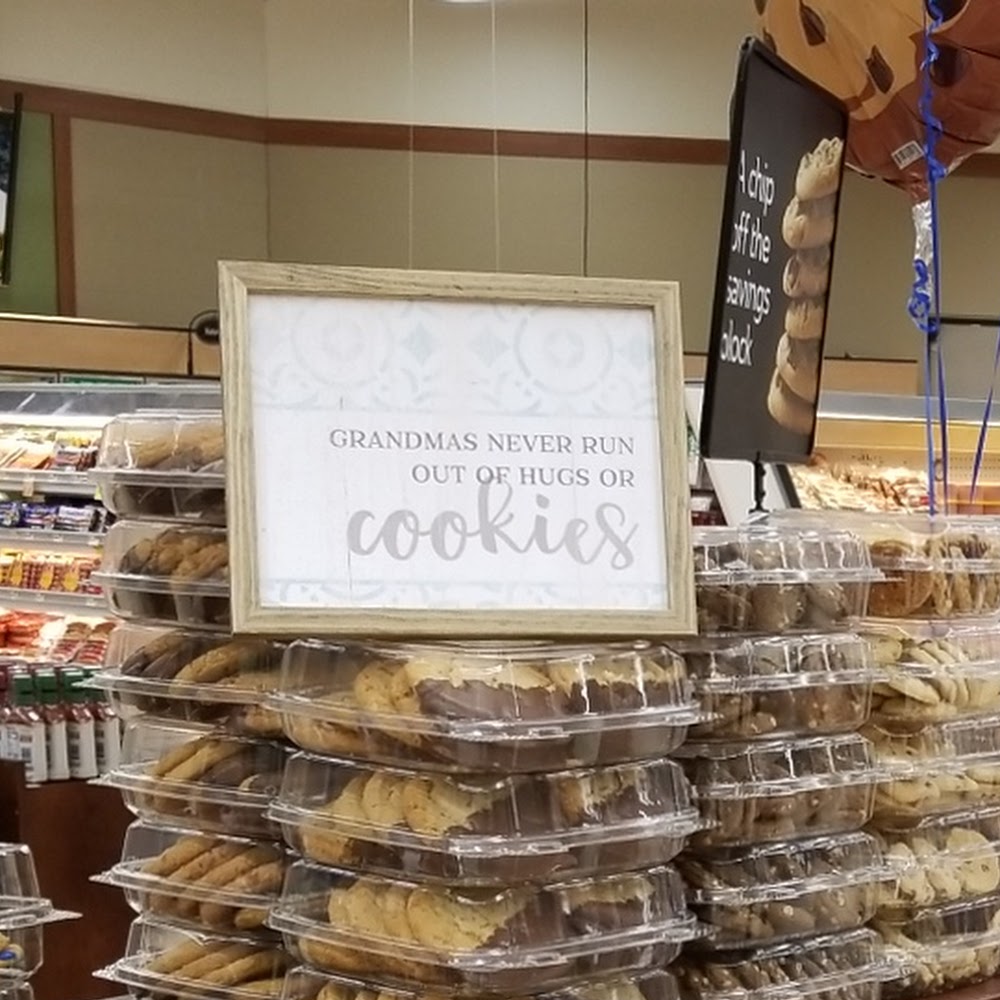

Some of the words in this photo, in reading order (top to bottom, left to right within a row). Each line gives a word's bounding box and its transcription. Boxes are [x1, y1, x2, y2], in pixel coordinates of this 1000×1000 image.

[748, 156, 775, 216] chip
[749, 217, 772, 263] the
[328, 428, 479, 452] GRANDMAS
[486, 433, 573, 455] NEVER
[581, 435, 636, 456] RUN
[411, 464, 467, 485] OUT
[475, 465, 511, 486] OF
[519, 466, 591, 487] HUGS
[599, 468, 636, 489] OR
[346, 474, 639, 571] cookies
